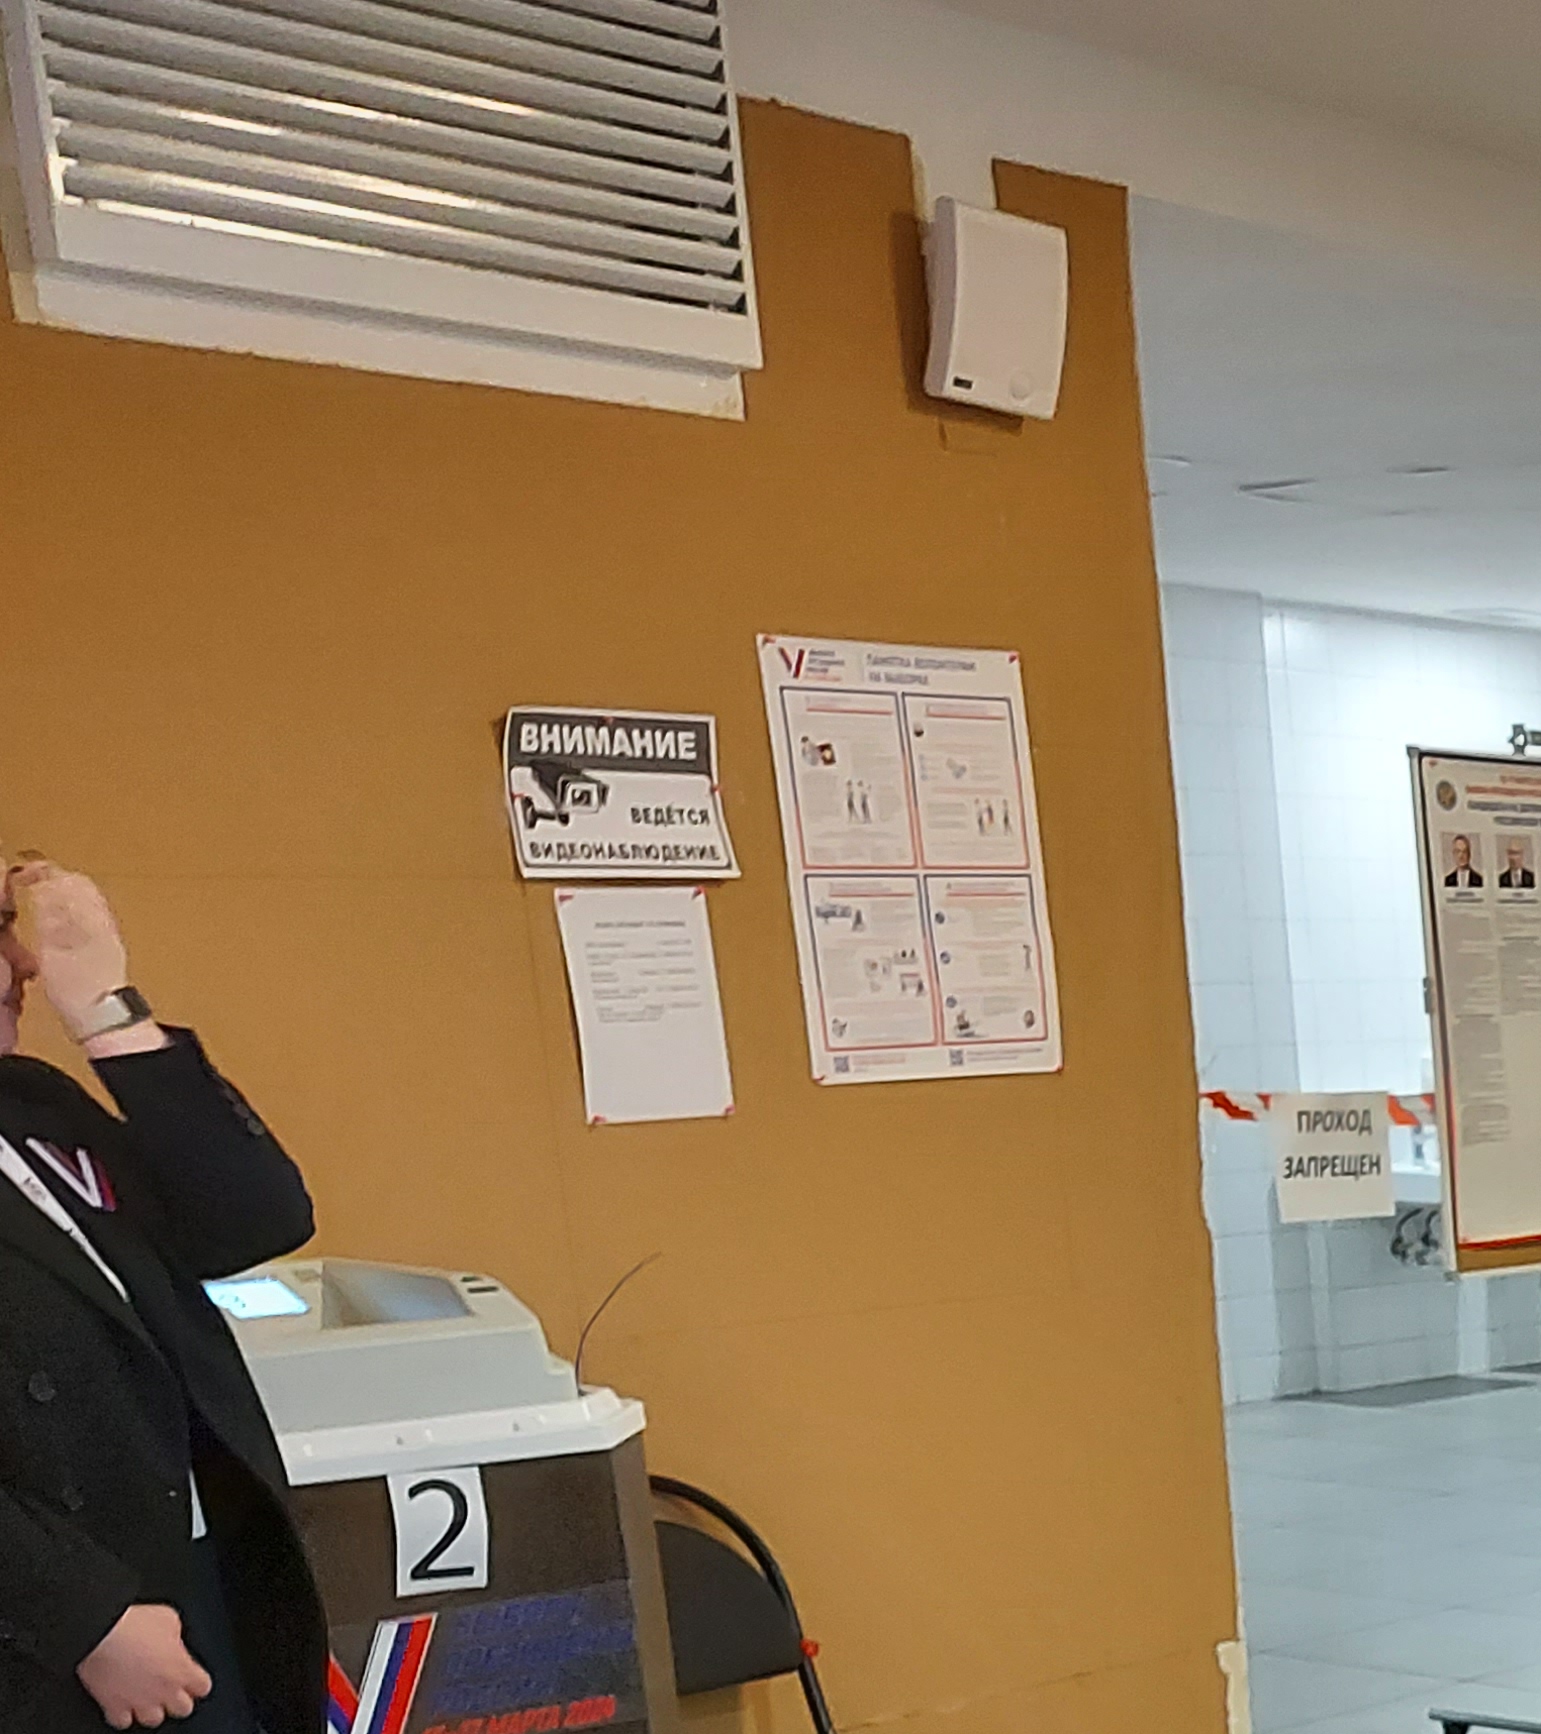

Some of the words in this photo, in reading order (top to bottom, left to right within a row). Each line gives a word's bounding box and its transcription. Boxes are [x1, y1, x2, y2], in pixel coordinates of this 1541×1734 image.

[518, 720, 698, 761] ВНИМАНИЕ
[629, 804, 712, 828] ВЕДЁТСЯ
[528, 838, 723, 864] ВИДЕОНАБЛЮДЕНИЕ
[1297, 1108, 1373, 1136] ПРОХОД
[1282, 1154, 1382, 1181] ЗАПРЕЩЕН
[407, 1479, 476, 1581] 2
